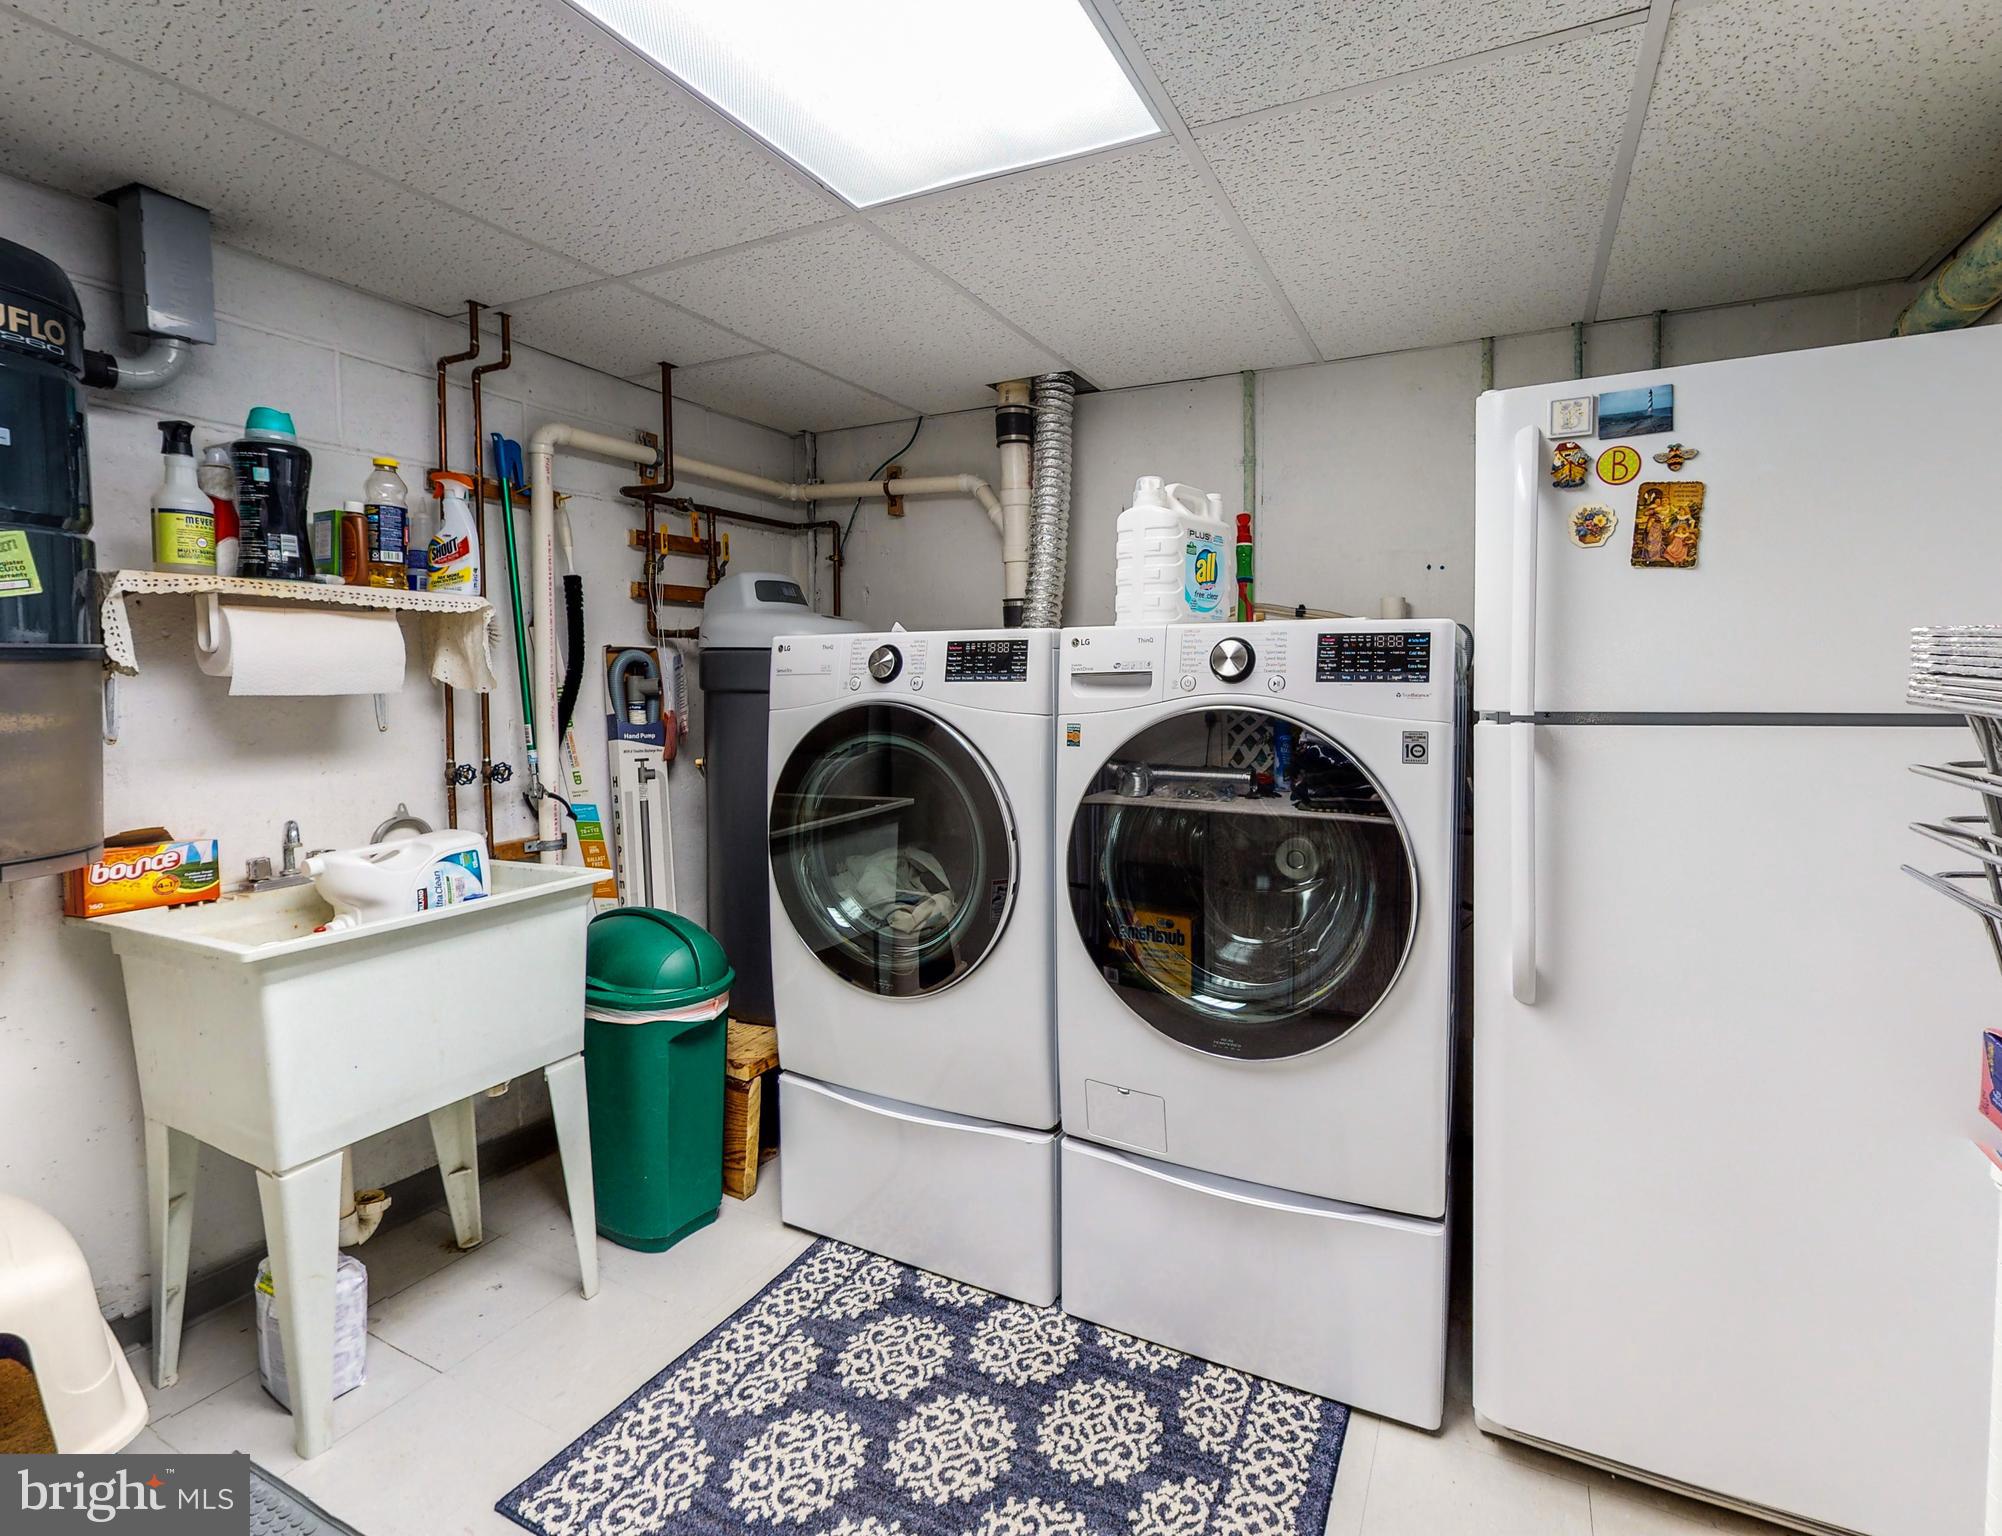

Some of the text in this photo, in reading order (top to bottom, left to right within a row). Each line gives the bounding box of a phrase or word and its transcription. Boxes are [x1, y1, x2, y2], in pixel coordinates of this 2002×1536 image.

[1611, 449, 1629, 481] B
[432, 536, 458, 560] SHOUT
[1196, 550, 1217, 583] all
[1194, 590, 1205, 598] free
[1080, 638, 1091, 646] LG
[640, 732, 656, 740] Pump
[572, 770, 582, 786] LED
[90, 850, 180, 885] bounce
[434, 870, 444, 895] Clean
